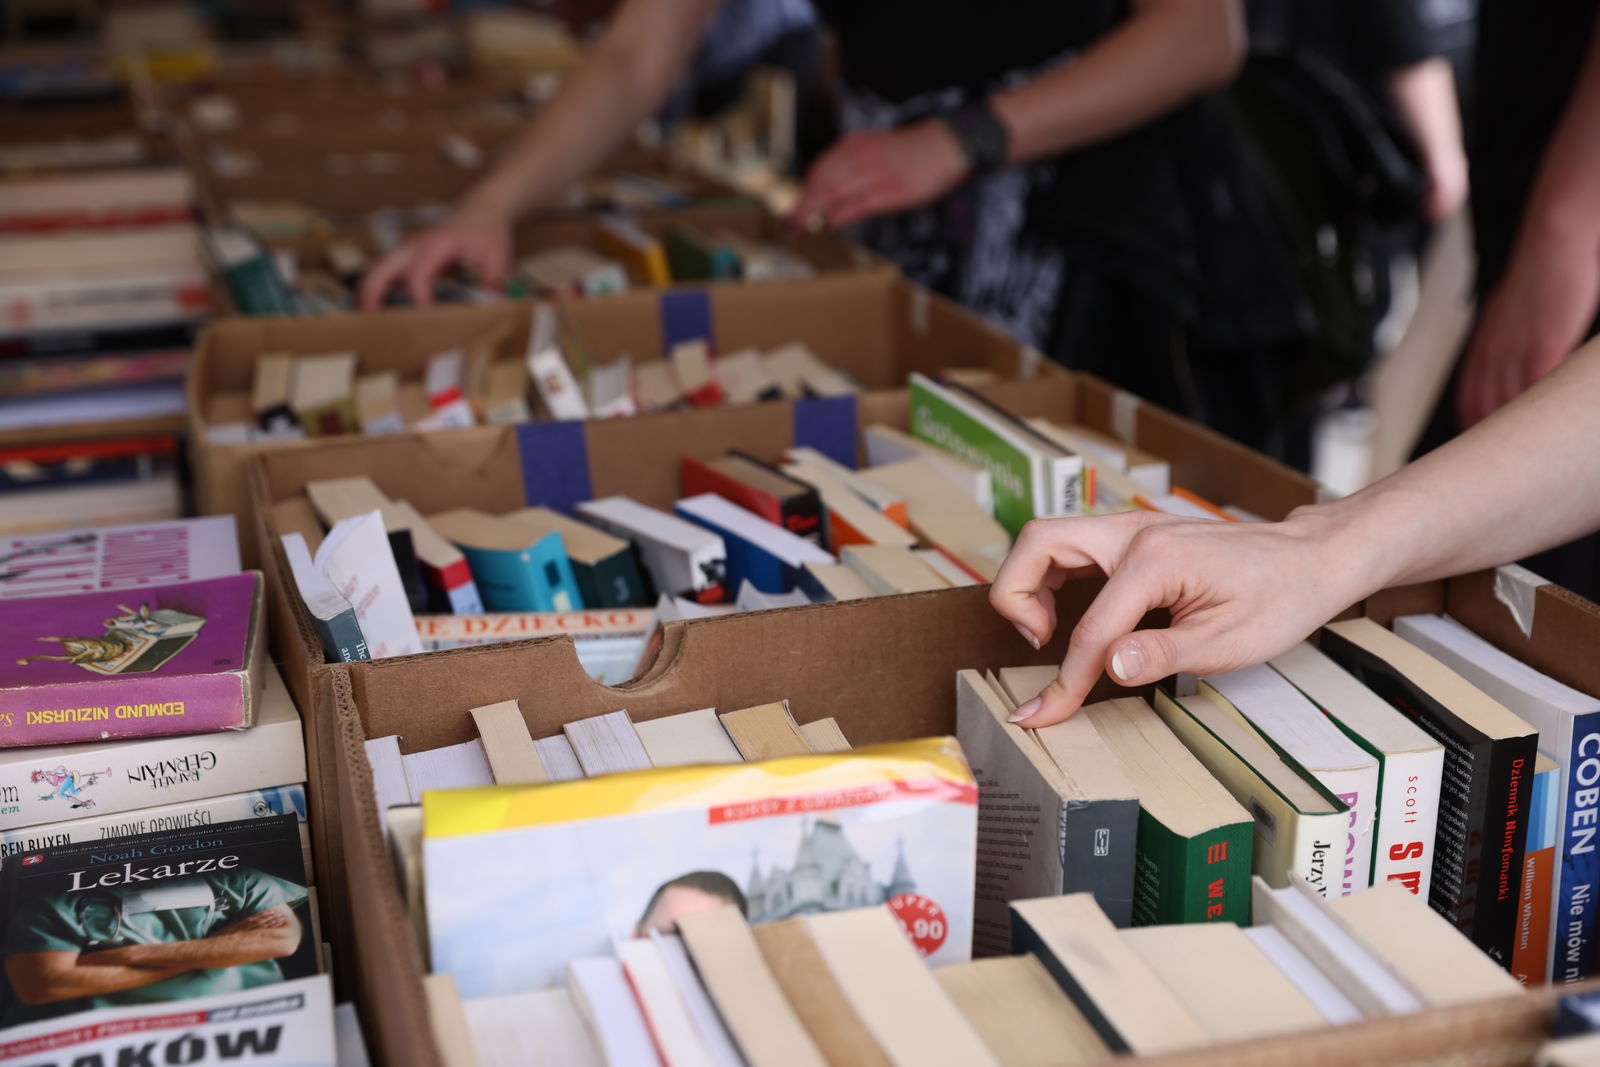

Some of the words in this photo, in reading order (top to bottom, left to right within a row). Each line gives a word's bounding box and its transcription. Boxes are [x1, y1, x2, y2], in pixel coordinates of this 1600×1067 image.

[464, 612, 637, 634] DZIECKO
[26, 706, 109, 725] NIZIURSKI
[114, 701, 185, 718] EDMUND
[127, 750, 217, 785] GERMAIN
[1504, 758, 1525, 817] Dziennik
[1570, 731, 1600, 856] COBEN
[100, 821, 146, 840] ZIMOWE
[150, 809, 212, 832] OPOWIEŚCI
[90, 848, 142, 864] Noah
[150, 839, 223, 855] Gordon
[1305, 840, 1332, 886] Jerzy
[1496, 820, 1518, 902] Nimfomanki
[66, 854, 240, 893] Lekarze
[1521, 857, 1536, 900] William
[1571, 884, 1591, 917] Nie
[1519, 903, 1533, 951] Wharton
[1566, 919, 1587, 962] mów
[1564, 967, 1586, 987] ni
